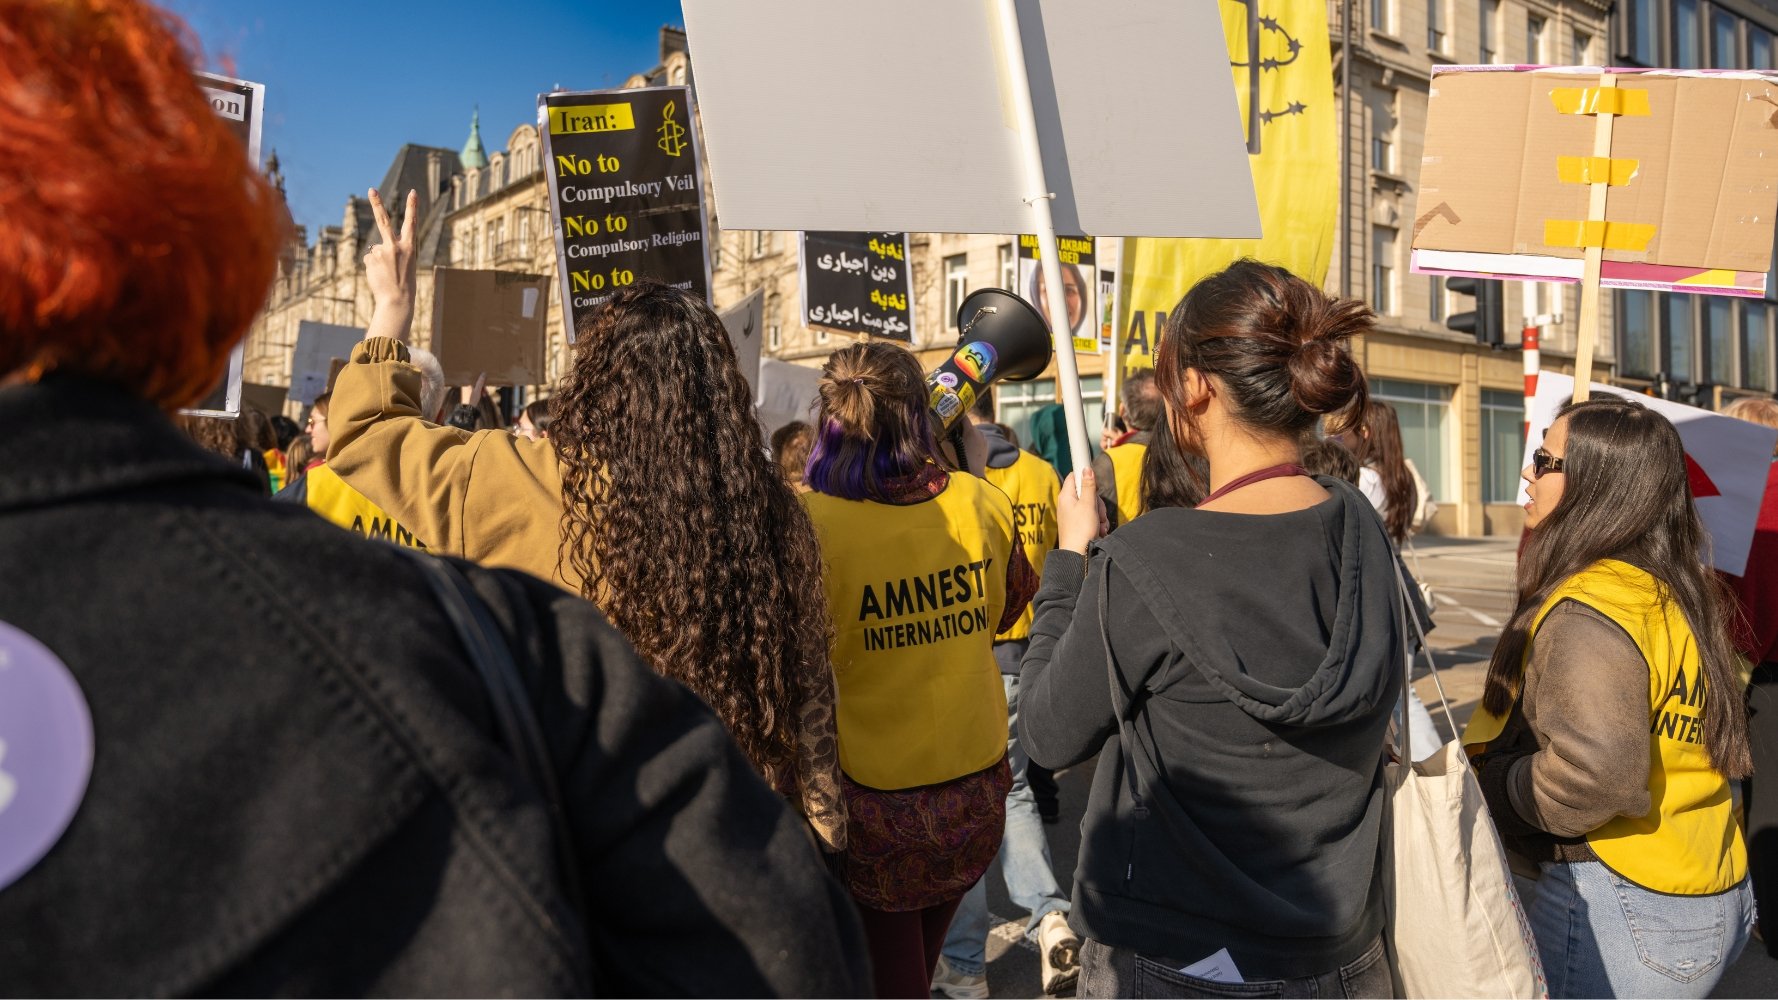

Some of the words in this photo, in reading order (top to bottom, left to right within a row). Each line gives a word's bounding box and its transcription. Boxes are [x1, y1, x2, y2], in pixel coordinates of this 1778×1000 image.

[560, 111, 617, 132] Iran:
[556, 154, 592, 177] No
[597, 153, 620, 173] to
[561, 180, 662, 204] Compulsory
[665, 174, 694, 191] Veil
[564, 215, 599, 238] No
[605, 213, 628, 233] to
[568, 238, 650, 259] Compulsory
[651, 230, 700, 247] Religion
[1061, 238, 1092, 254] AKBARI
[816, 251, 869, 276] اجباری
[870, 264, 897, 283] دین
[571, 269, 605, 293] No
[611, 267, 634, 287] to
[808, 302, 860, 326] اجباری
[861, 312, 909, 335] حکومت
[1013, 503, 1046, 527] STY
[864, 605, 989, 651] INTERNATION
